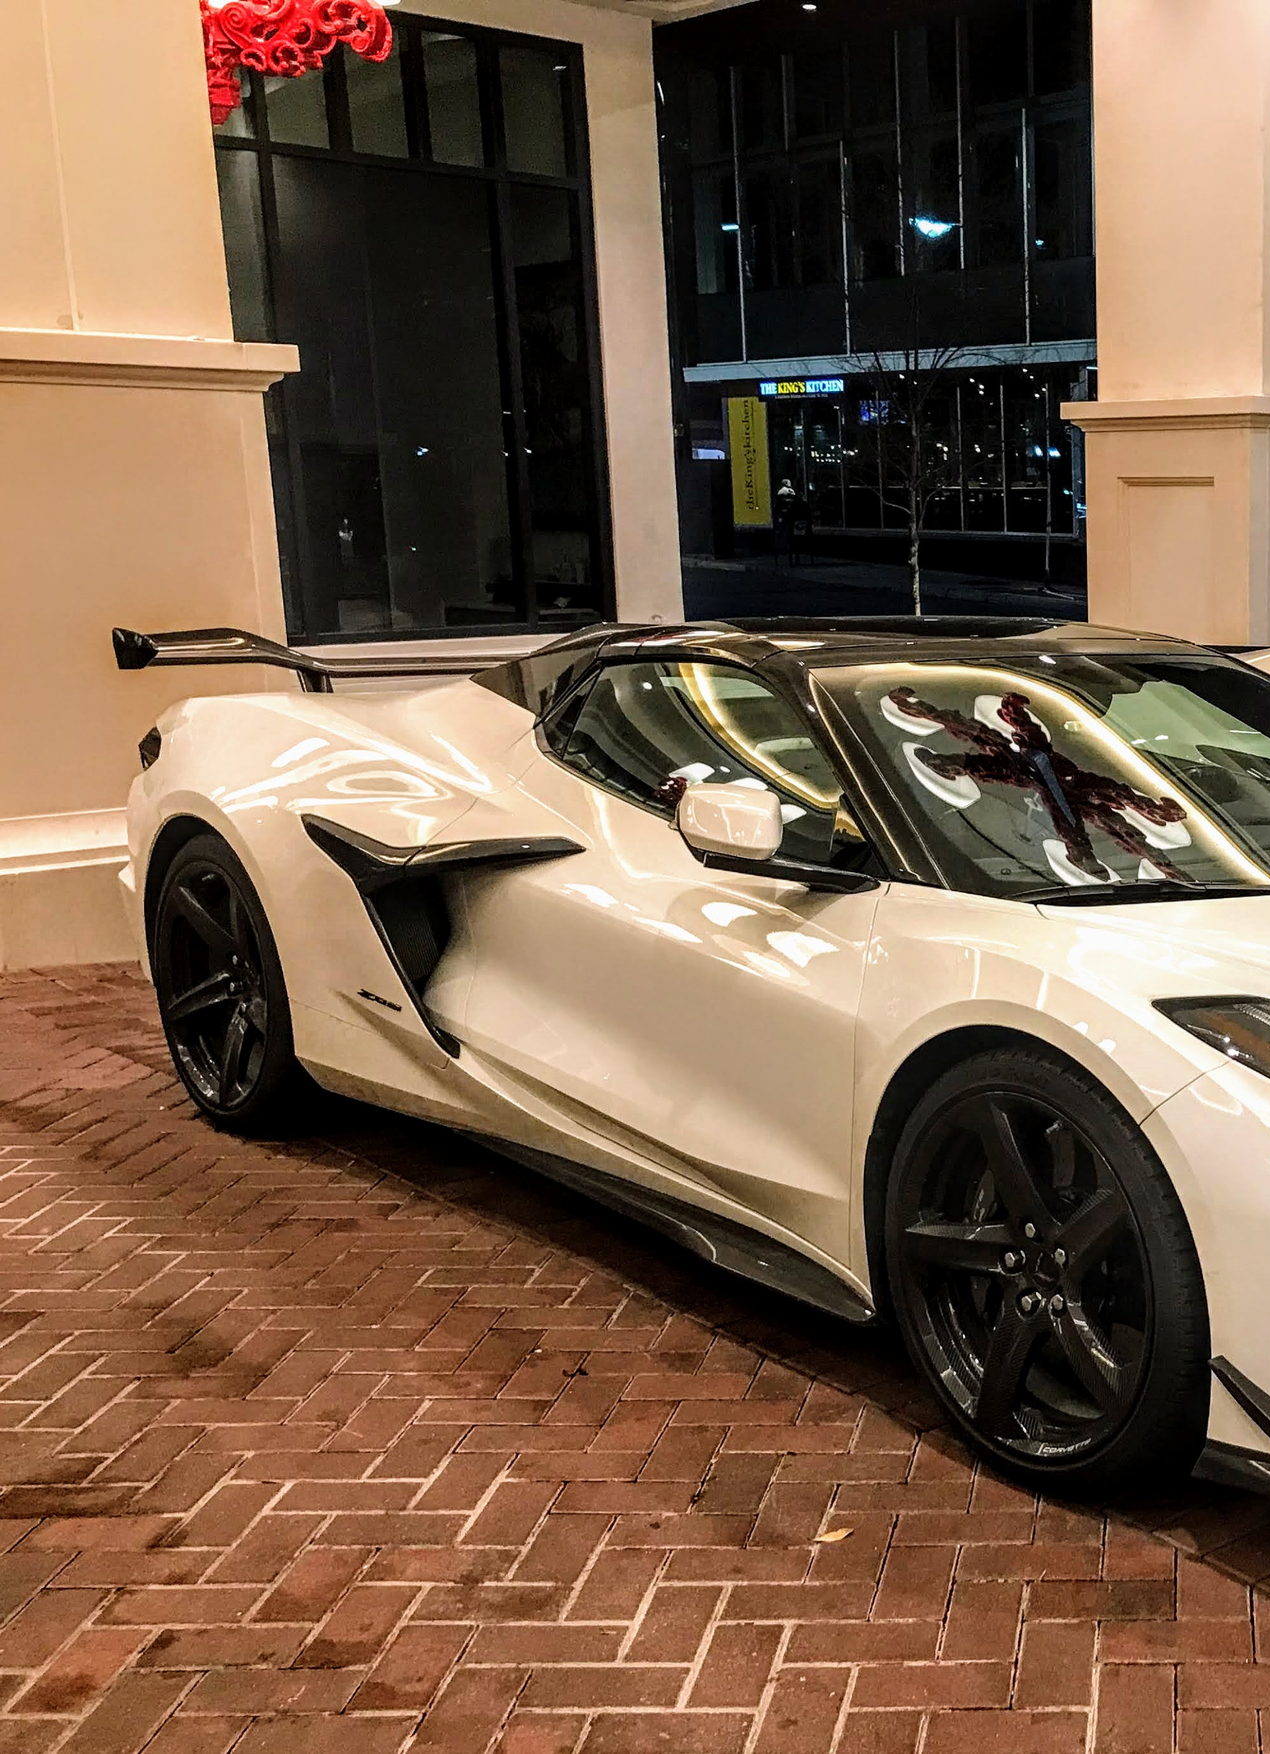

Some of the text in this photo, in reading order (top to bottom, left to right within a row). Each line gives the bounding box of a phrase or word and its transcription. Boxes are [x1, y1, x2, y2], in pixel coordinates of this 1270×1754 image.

[760, 379, 844, 395] THE KING'S KITCHEN
